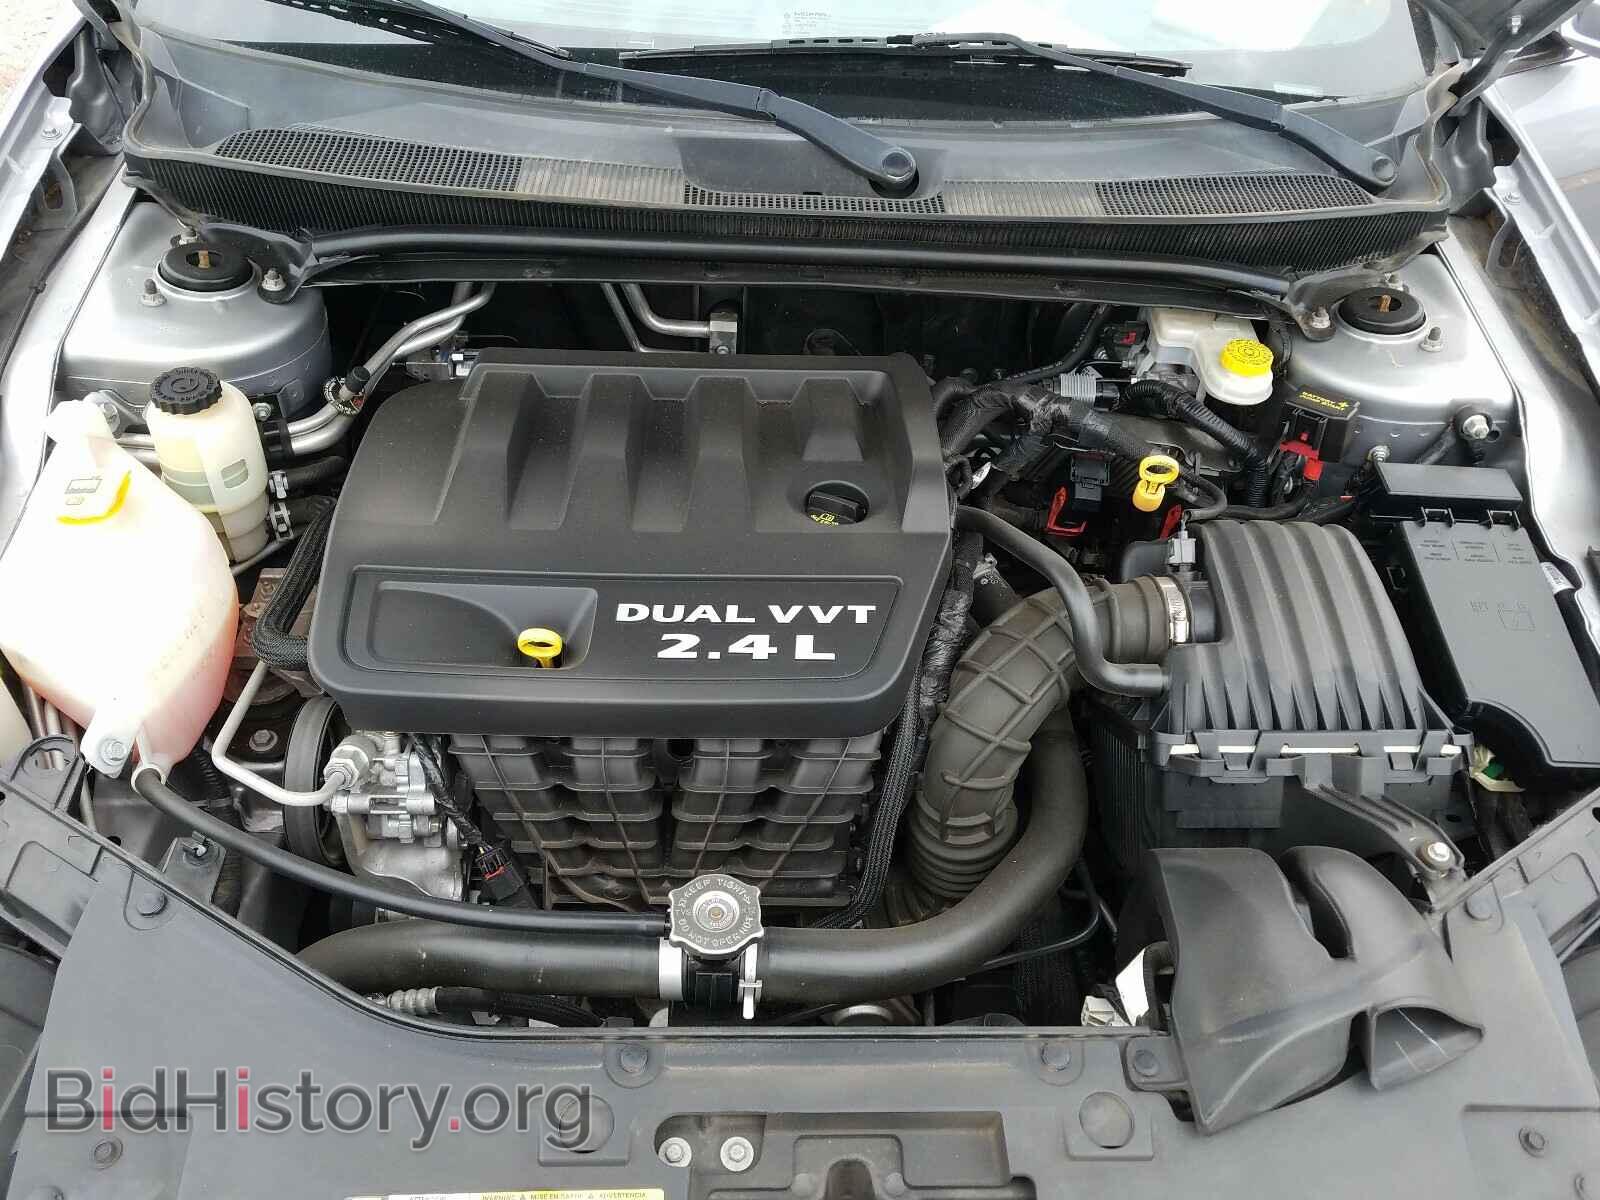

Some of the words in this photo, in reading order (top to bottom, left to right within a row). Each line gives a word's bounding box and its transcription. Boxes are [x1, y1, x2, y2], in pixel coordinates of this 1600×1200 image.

[615, 603, 756, 623] DUAL
[767, 605, 877, 624] VVT
[684, 879, 711, 898] KEEP
[718, 879, 747, 897] TIGHT
[678, 918, 690, 932] DO
[688, 930, 710, 945] NOT
[711, 932, 741, 947] OPEN
[739, 916, 754, 935] HOT
